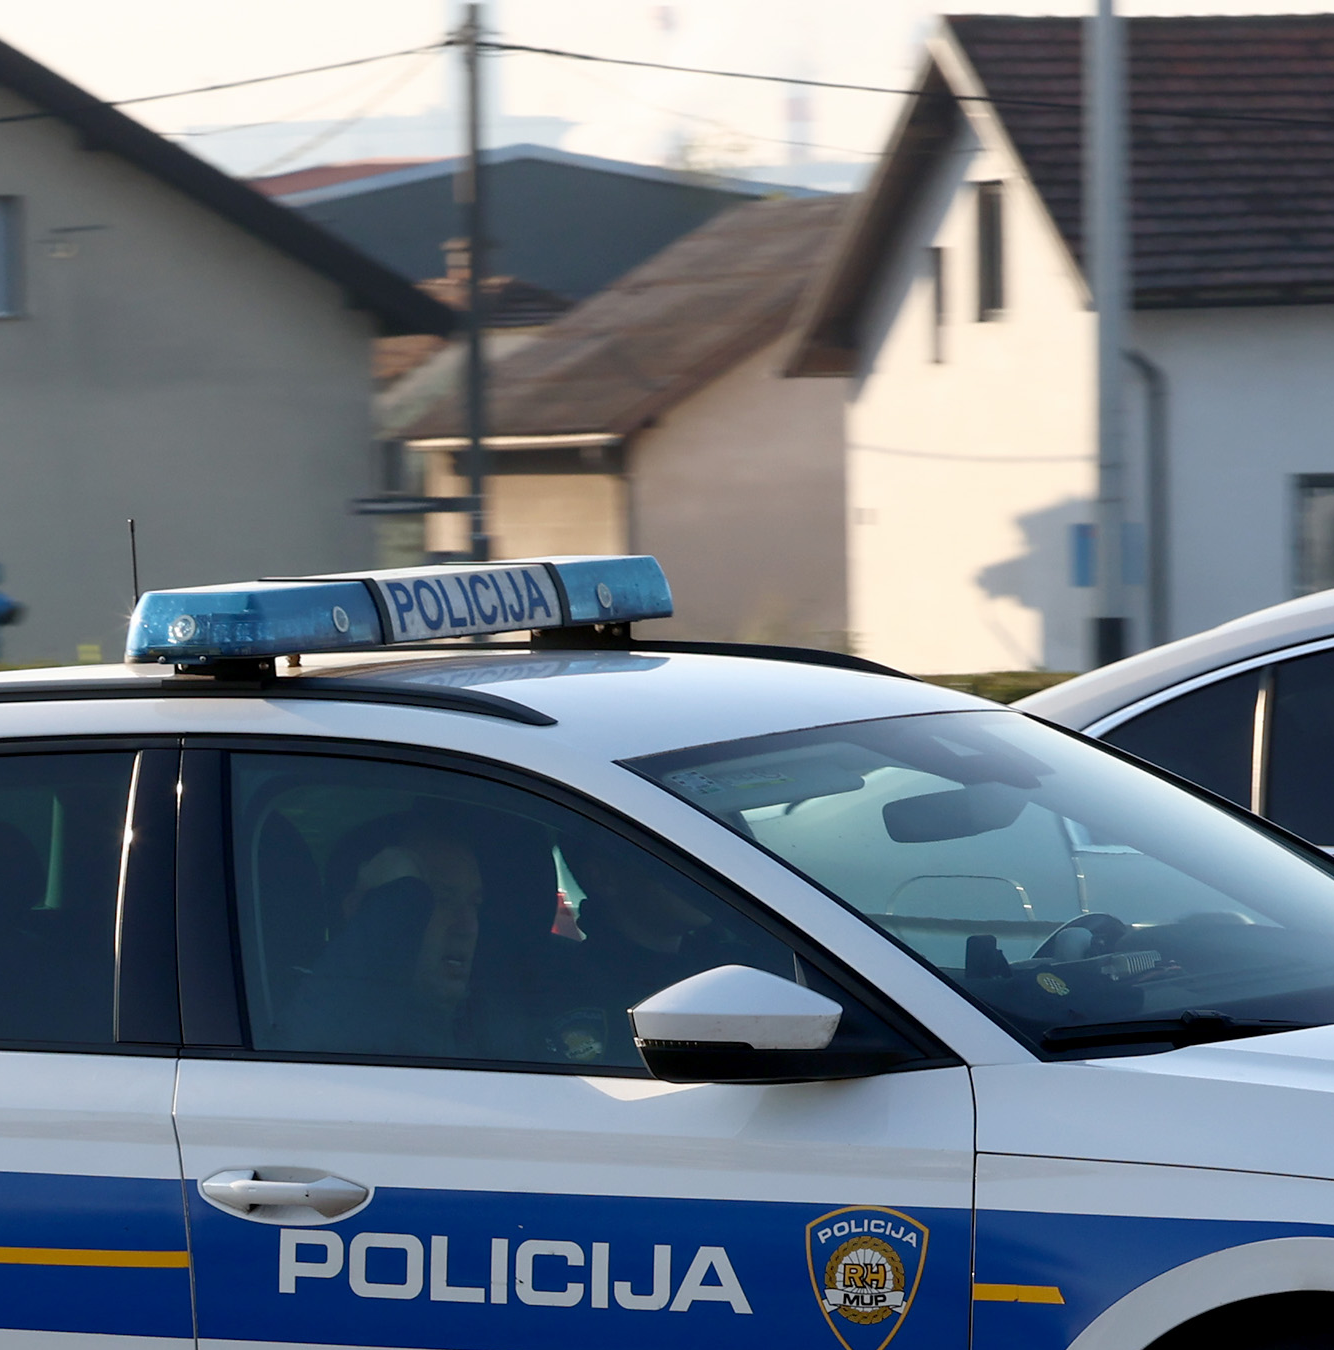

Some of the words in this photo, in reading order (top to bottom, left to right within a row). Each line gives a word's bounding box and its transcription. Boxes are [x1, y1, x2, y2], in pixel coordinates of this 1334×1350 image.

[386, 569, 552, 633] POLICIJA
[817, 1219, 918, 1248] POLICIJA
[277, 1227, 754, 1315] POLICIJA
[842, 1263, 887, 1290] RH
[842, 1293, 887, 1307] MUP
